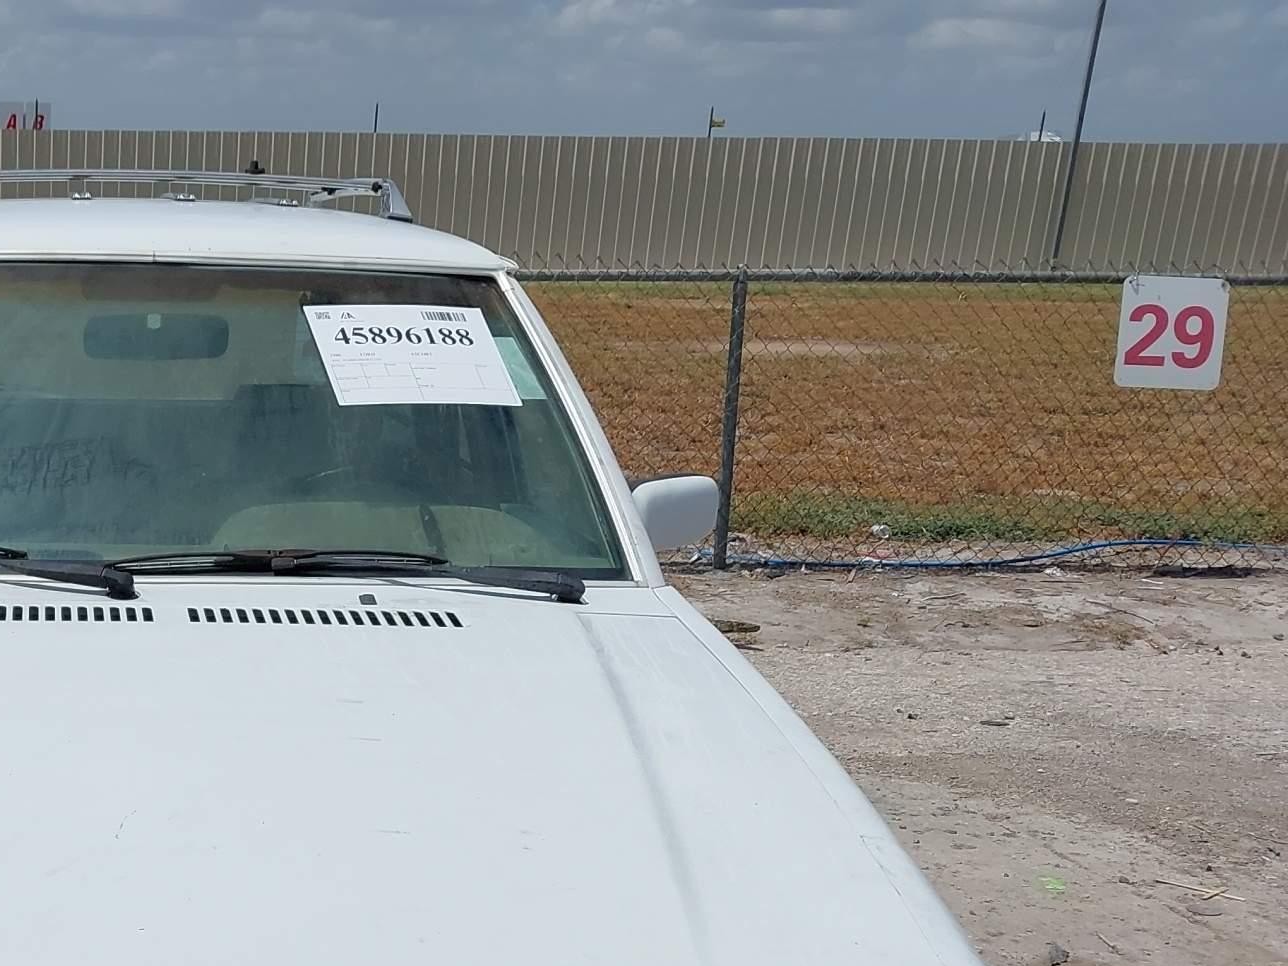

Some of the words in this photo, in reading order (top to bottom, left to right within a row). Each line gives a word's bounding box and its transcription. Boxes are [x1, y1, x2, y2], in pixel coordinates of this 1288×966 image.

[7, 113, 17, 129] A
[334, 326, 474, 346] 45896188
[1123, 303, 1215, 369] 29
